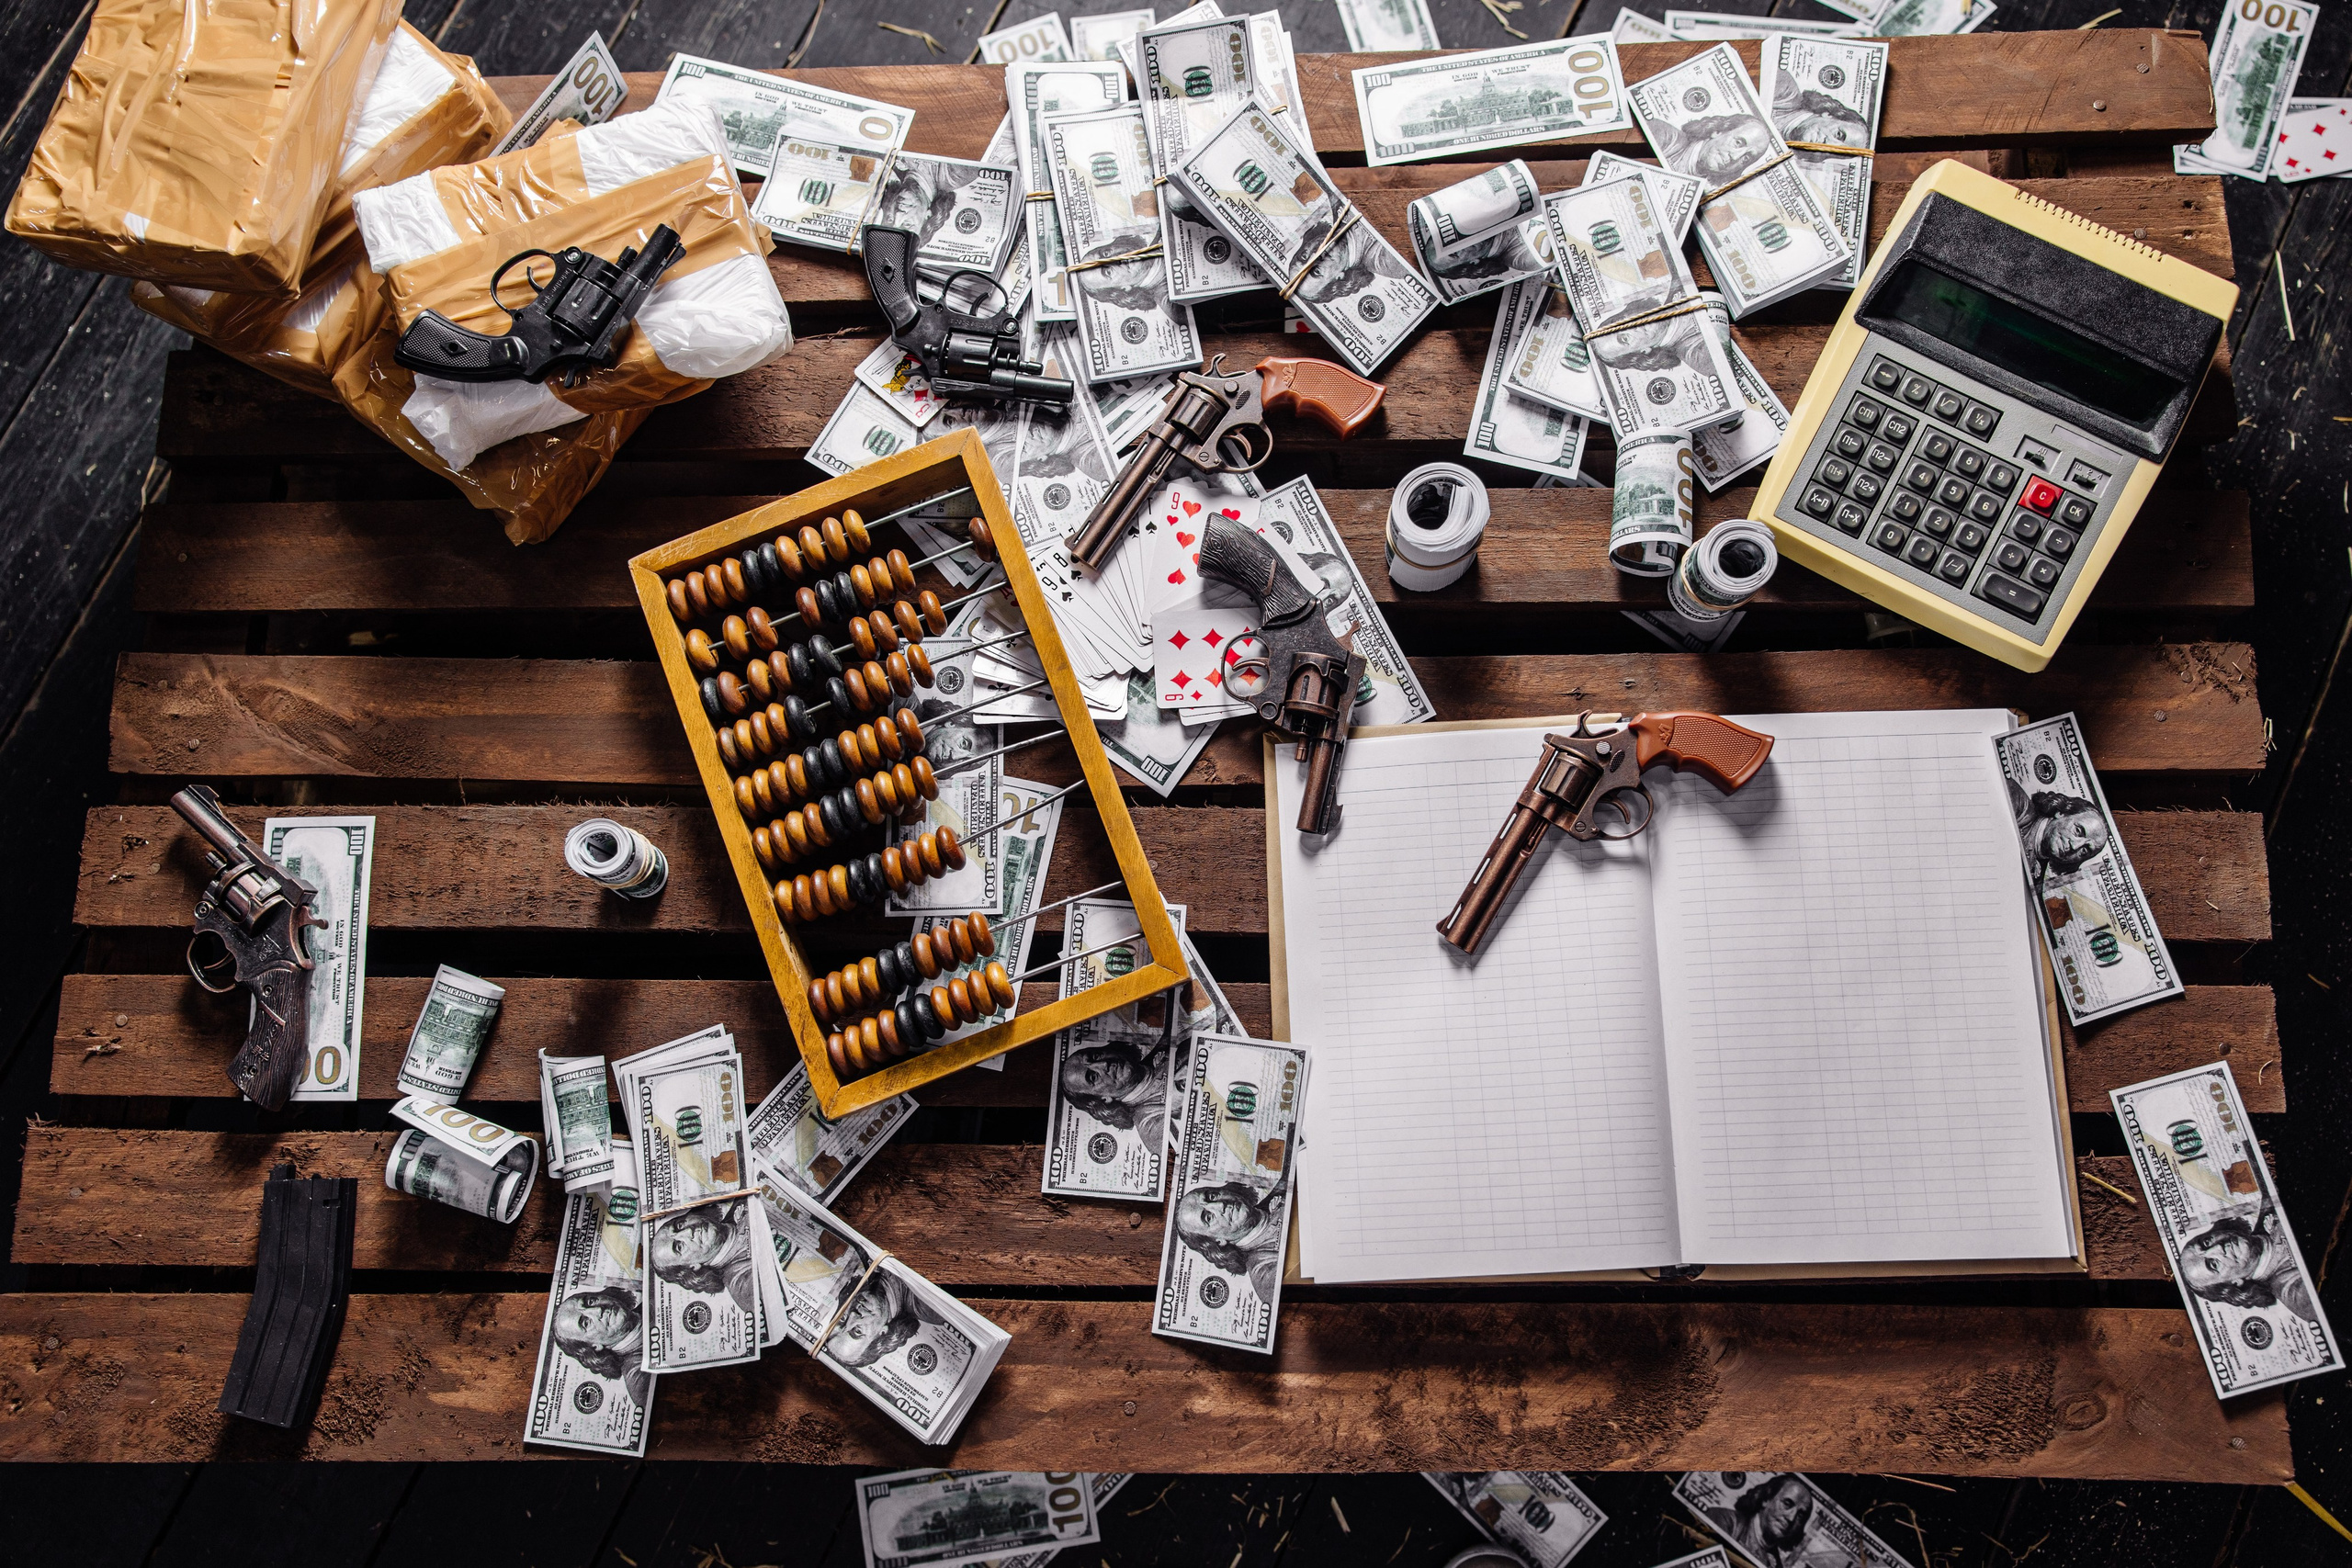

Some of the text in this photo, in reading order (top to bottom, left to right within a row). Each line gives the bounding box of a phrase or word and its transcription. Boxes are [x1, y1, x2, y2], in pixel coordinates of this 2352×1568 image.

[681, 62, 707, 78] 100
[1147, 48, 1160, 85] 100
[1230, 32, 1245, 82] 100
[1437, 61, 1467, 71] UNITED
[1467, 56, 1498, 66] STATES
[1509, 50, 1545, 60] AMERICA
[1715, 50, 1738, 80] 100
[1779, 43, 1792, 73] 100
[1868, 50, 1883, 82] 100
[573, 56, 615, 117] 100
[1364, 73, 1392, 87] 100
[1566, 49, 1615, 119] 100
[1636, 92, 1655, 120] 100
[1053, 131, 1068, 164] 100
[1249, 114, 1287, 154] 100
[1470, 131, 1508, 141] HUNDRED
[1508, 125, 1545, 136] DOLLARS
[787, 143, 830, 160] 100
[978, 169, 1009, 181] 100
[1190, 170, 1221, 203] 100
[762, 215, 797, 229] 100
[1548, 206, 1567, 242] 100
[1811, 220, 1838, 252] 100
[958, 254, 992, 264] 100
[1171, 258, 1184, 291] 100
[1725, 244, 1756, 290] 100
[1403, 273, 1428, 296] 100
[1088, 333, 1104, 369] 100
[1178, 321, 1195, 353] 100
[1343, 333, 1374, 366] 100
[1476, 422, 1495, 447] 100
[1966, 457, 1973, 465] 8
[1997, 471, 2004, 479] 9
[1171, 492, 1181, 510] 9
[1295, 483, 1319, 517] 100
[1950, 486, 1956, 494] 5
[1887, 531, 1894, 539] 0
[1935, 516, 1941, 525] 2
[1967, 532, 1973, 540] 3
[1053, 553, 1069, 568] 8
[1396, 675, 1422, 710] 100
[2045, 731, 2052, 742] B2
[2062, 720, 2081, 758] 100
[1141, 756, 1170, 781] 100
[1999, 746, 2009, 778] 100
[348, 828, 363, 855] 100
[983, 863, 994, 897] 100
[2100, 853, 2142, 942] UNITED STATES
[2101, 877, 2131, 935] AMERICA
[351, 906, 359, 937] UNITED
[1071, 913, 1085, 951] 100
[349, 939, 357, 971] STATES
[2143, 942, 2167, 981] 100
[349, 973, 356, 983] OF
[2057, 953, 2091, 1010] 100
[1193, 1047, 1208, 1086] 100
[719, 1067, 735, 1125] 100
[1279, 1059, 1297, 1111] 100
[642, 1086, 654, 1124] 100
[2208, 1082, 2239, 1134] 100
[1179, 1135, 1190, 1180] HUNDRED
[1185, 1091, 1195, 1134] DOLLARS
[1190, 1090, 1210, 1185] UNITED STATES
[1200, 1101, 1216, 1176] OF AMERICA
[2122, 1103, 2145, 1144] 100
[1050, 1145, 1064, 1184] 100
[1081, 1171, 1089, 1182] B2
[1148, 1154, 1160, 1190] 100
[2147, 1144, 2188, 1239] UNITED STATES
[2158, 1152, 2188, 1213] AMERICA
[567, 1196, 578, 1240] DOLLARS
[761, 1183, 802, 1219] 100
[570, 1197, 593, 1291] UNITED STATES
[580, 1208, 598, 1281] OF AMERICA
[1176, 1262, 1184, 1293] RESERVE
[1159, 1286, 1175, 1326] 100
[1190, 1314, 1198, 1327] B2
[1256, 1301, 1272, 1340] 100
[649, 1325, 660, 1367] 100
[743, 1313, 755, 1348] 100
[942, 1318, 971, 1341] 100
[2307, 1320, 2332, 1360] 100
[679, 1346, 686, 1358] B2
[2208, 1346, 2233, 1389] 100
[2248, 1363, 2259, 1377] B2
[531, 1393, 549, 1435] 100
[628, 1406, 645, 1445] 100
[894, 1397, 932, 1423] 100
[562, 1422, 571, 1435] B2
